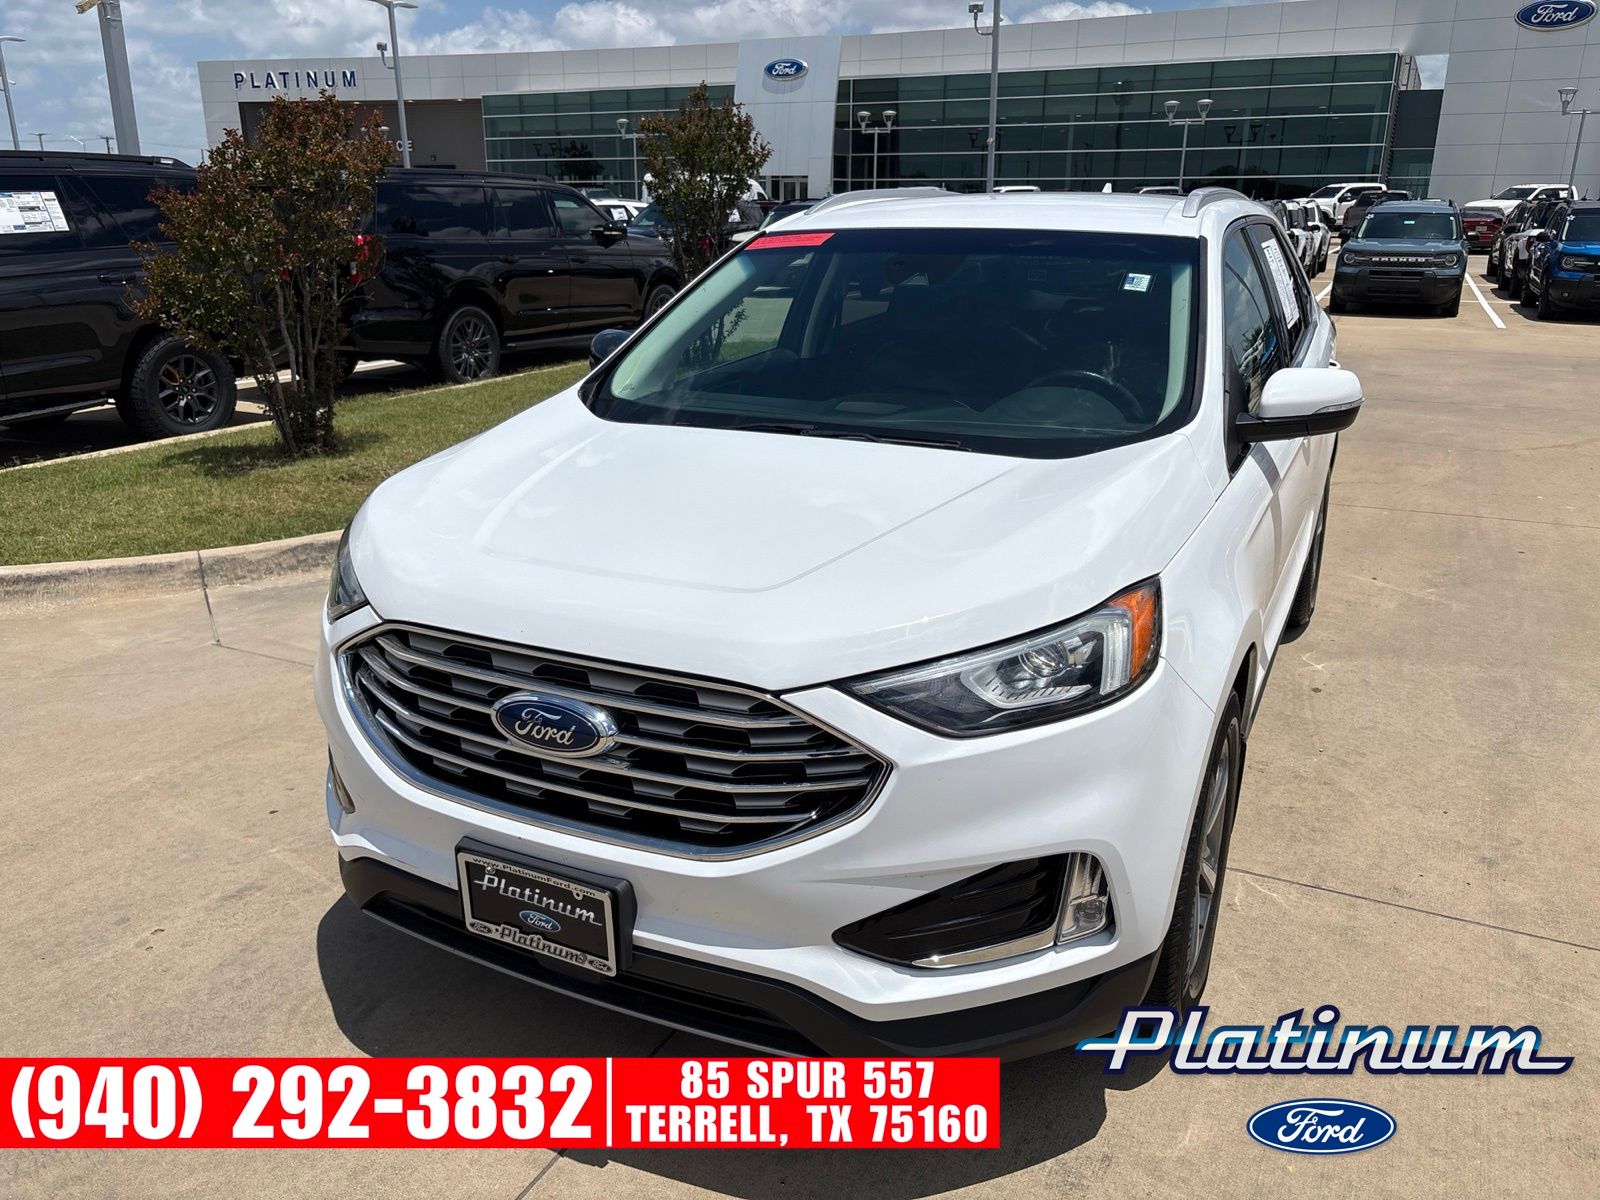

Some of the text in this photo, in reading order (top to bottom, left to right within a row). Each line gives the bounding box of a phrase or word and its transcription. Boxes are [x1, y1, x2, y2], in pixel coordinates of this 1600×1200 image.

[1531, 4, 1579, 23] Ford
[234, 70, 357, 89] PLATINUM
[772, 62, 797, 75] Ford
[514, 707, 577, 745] Ford
[472, 857, 596, 898] www.PlatinumFord.com
[474, 874, 603, 926] Platinum
[526, 912, 555, 931] Ford
[499, 924, 581, 964] Platinum
[590, 959, 611, 972] Ford
